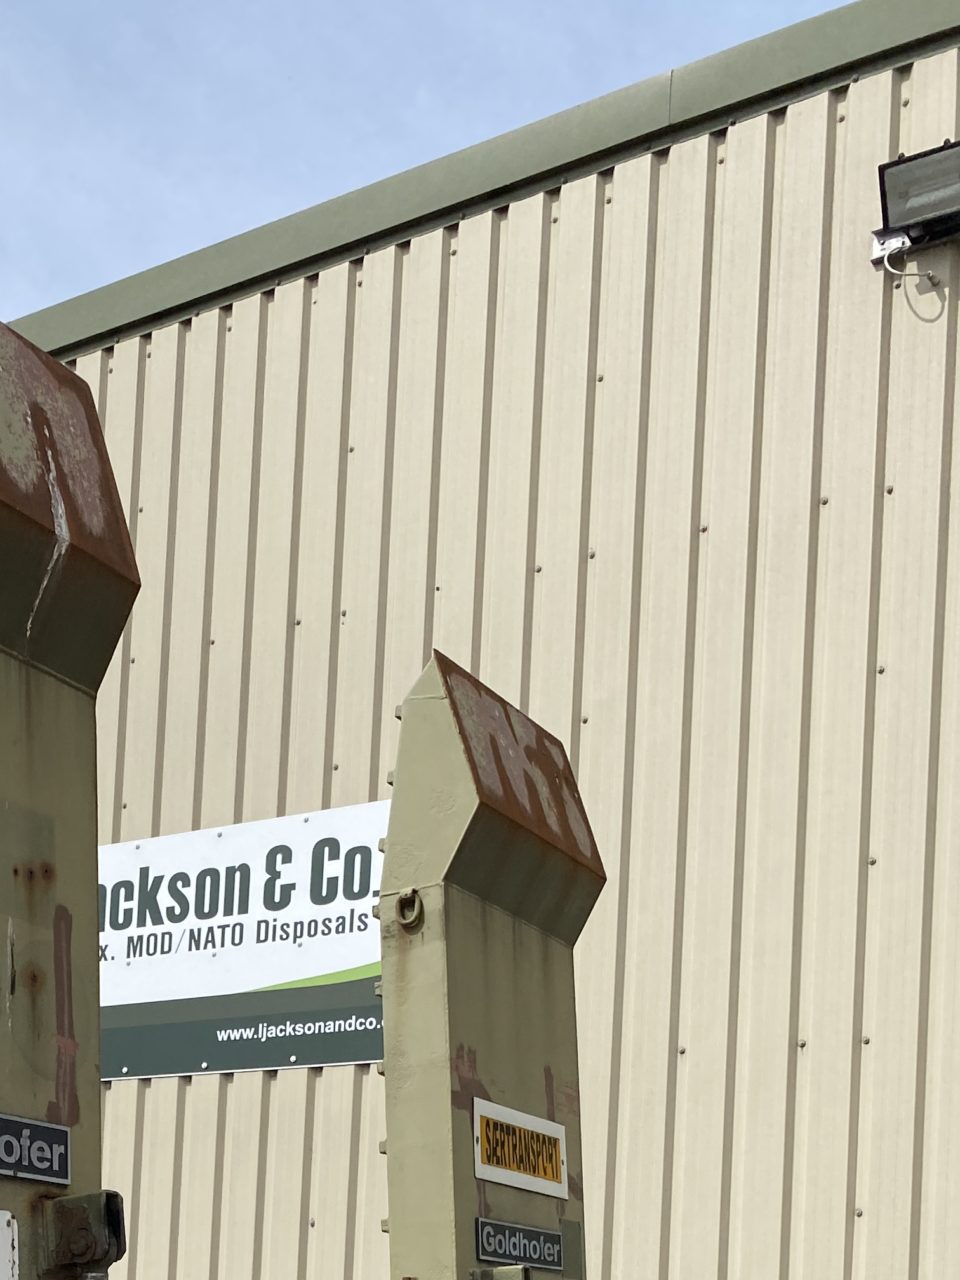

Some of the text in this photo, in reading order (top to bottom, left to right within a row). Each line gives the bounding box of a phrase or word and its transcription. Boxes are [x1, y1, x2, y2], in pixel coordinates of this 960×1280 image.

[263, 844, 296, 911] &
[126, 922, 244, 959] MOD/NATO
[256, 908, 369, 944] Disposals
[216, 1015, 384, 1042] www.ljacksonandco.
[482, 1225, 560, 1262] Goldhofer
